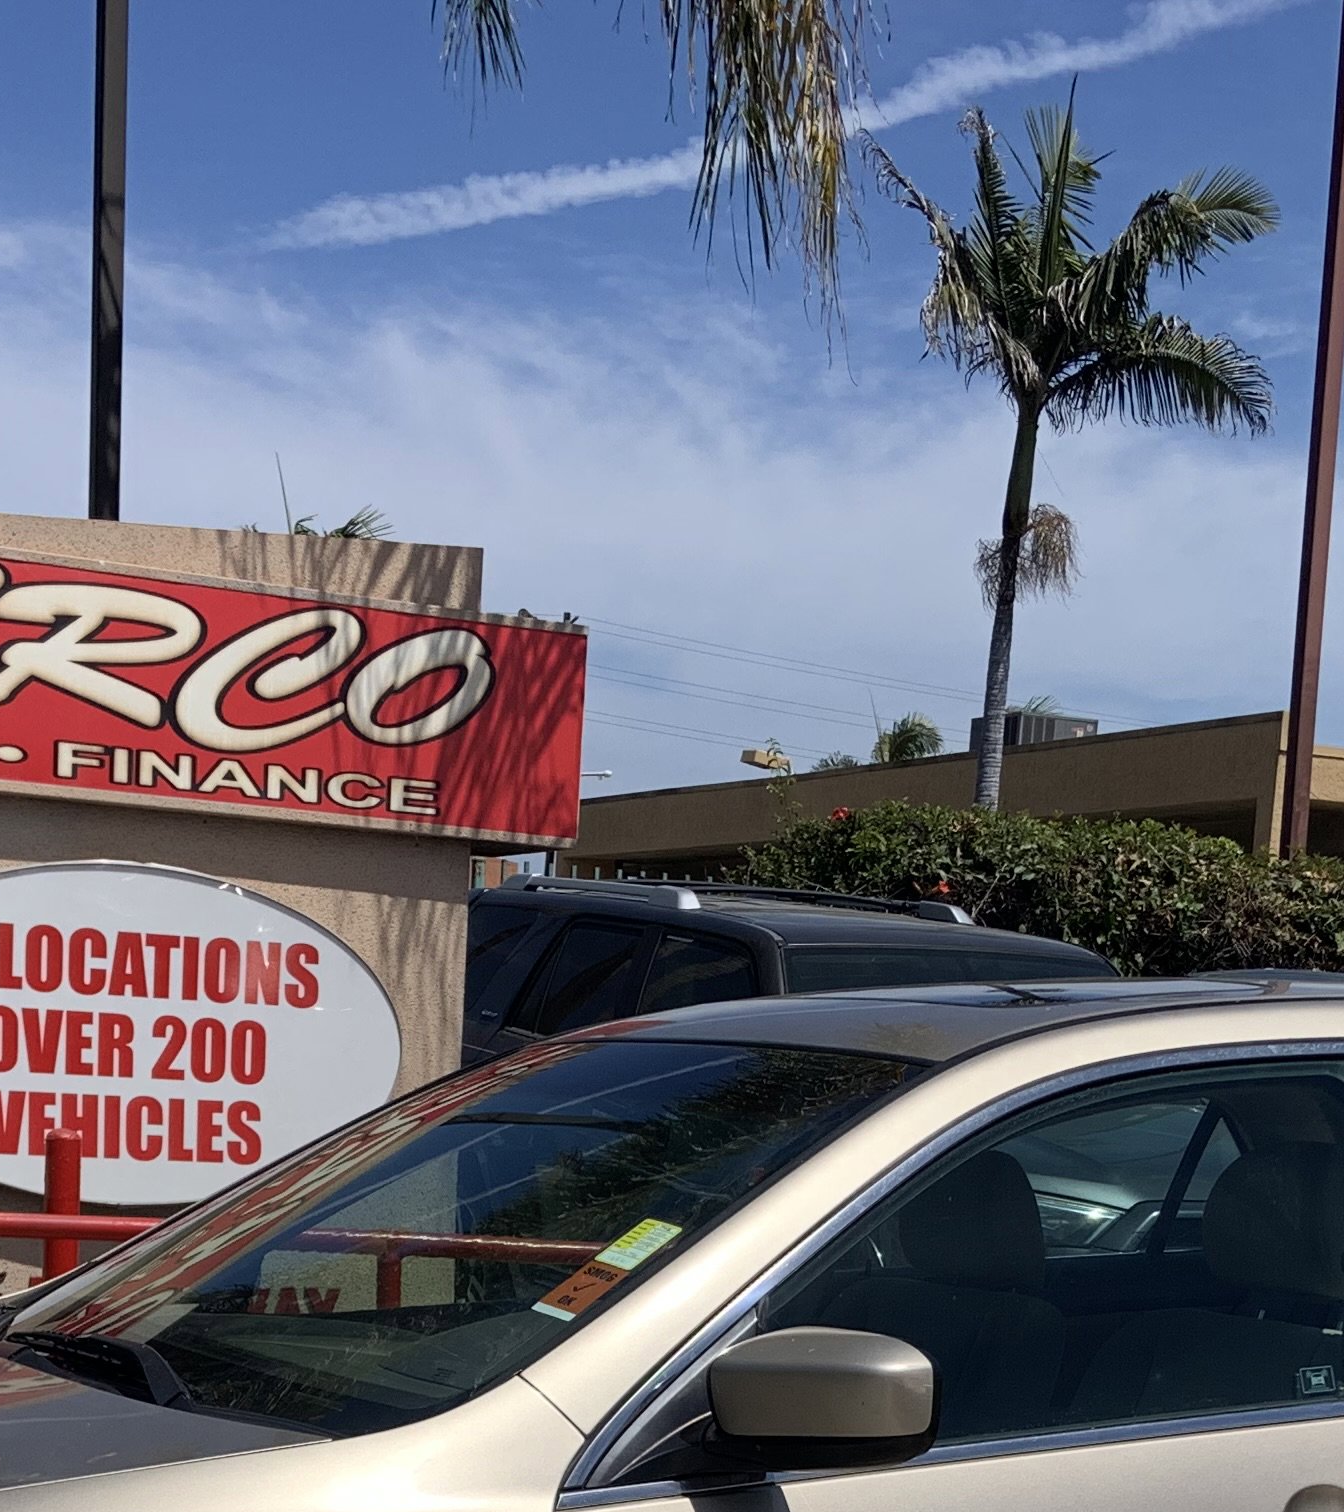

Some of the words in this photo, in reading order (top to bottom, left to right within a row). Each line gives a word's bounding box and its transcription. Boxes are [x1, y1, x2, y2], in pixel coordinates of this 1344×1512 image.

[54, 739, 441, 816] FINANCE
[151, 1015, 267, 1086] 200
[583, 1266, 618, 1282] SMOG
[557, 1294, 577, 1306] OK
